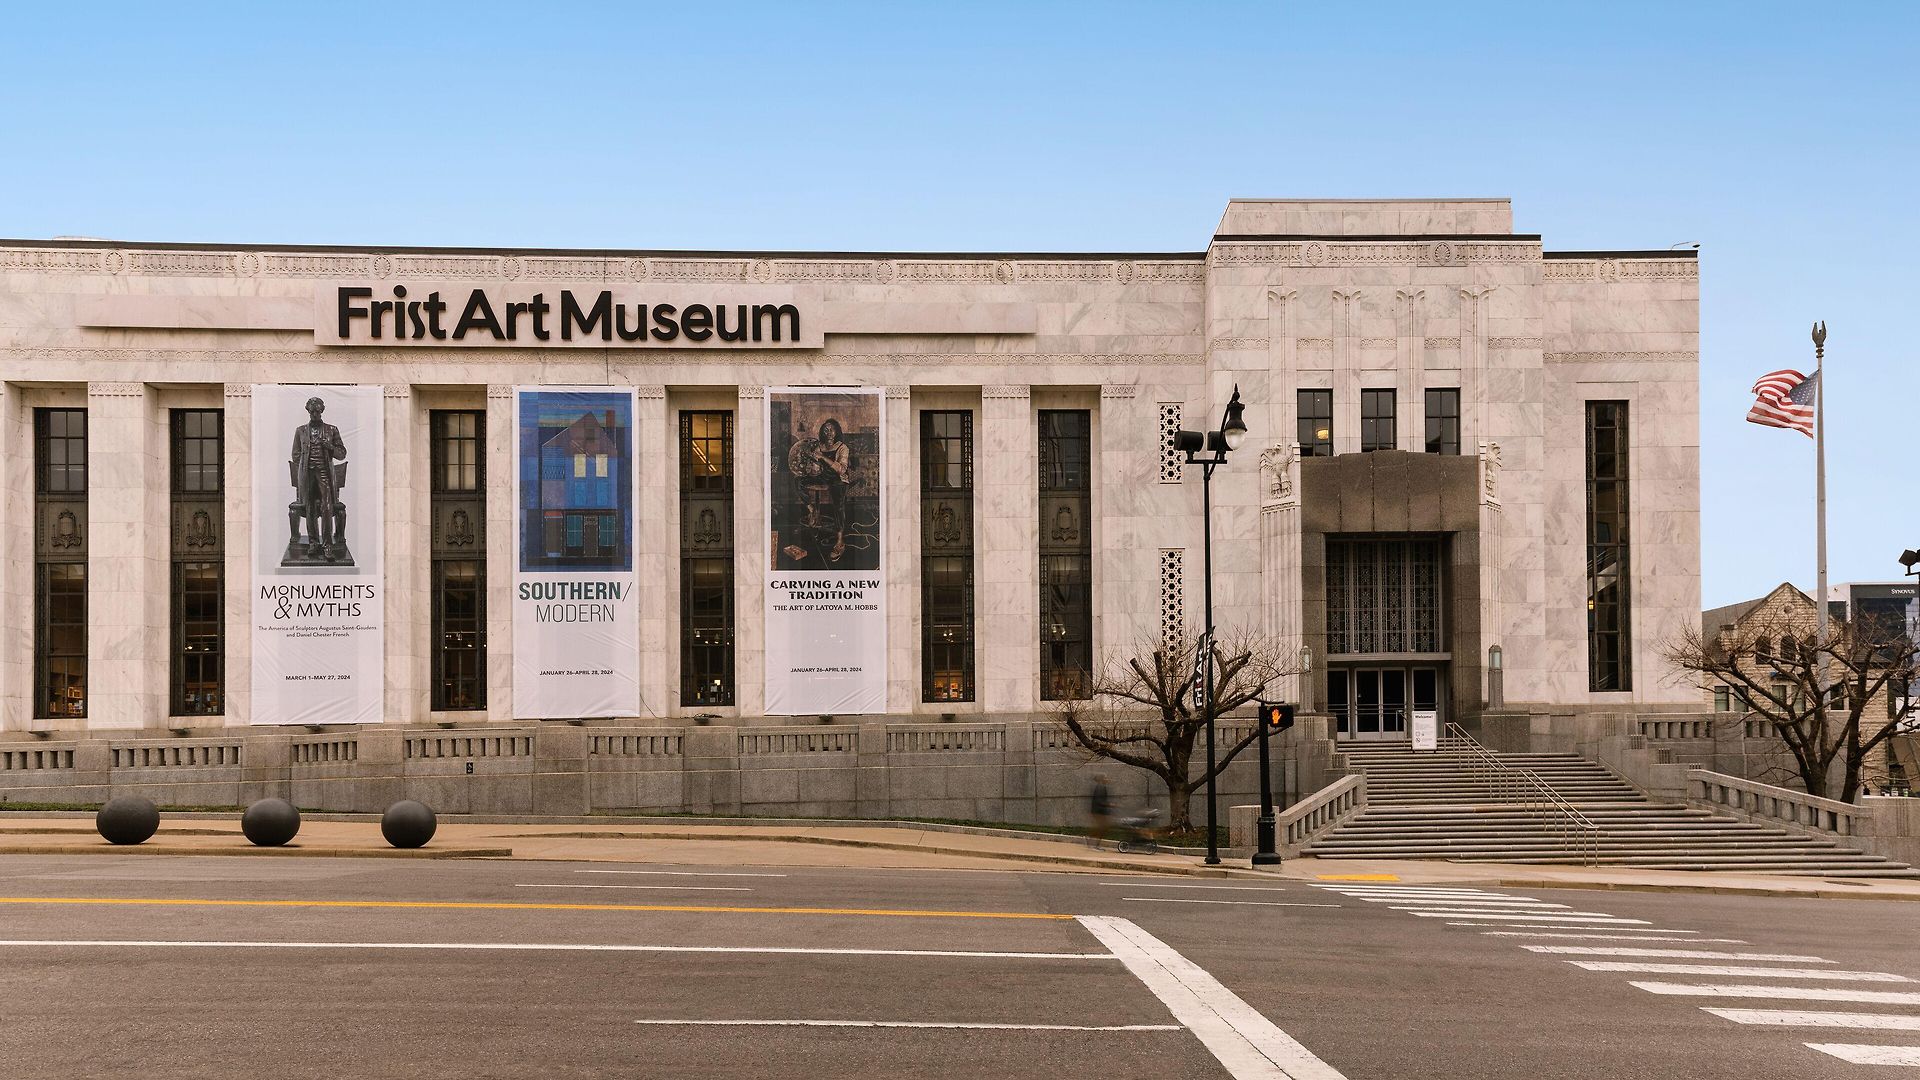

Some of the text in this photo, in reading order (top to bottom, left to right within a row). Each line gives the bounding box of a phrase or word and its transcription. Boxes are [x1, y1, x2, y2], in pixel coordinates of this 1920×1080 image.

[337, 284, 800, 342] Frist Art Museum
[260, 585, 375, 600] MONUMENTS
[770, 580, 880, 589] CARVING A NEW
[788, 591, 863, 600] TRADITION
[273, 596, 362, 620] & MYTHS
[536, 604, 615, 622] MODERN
